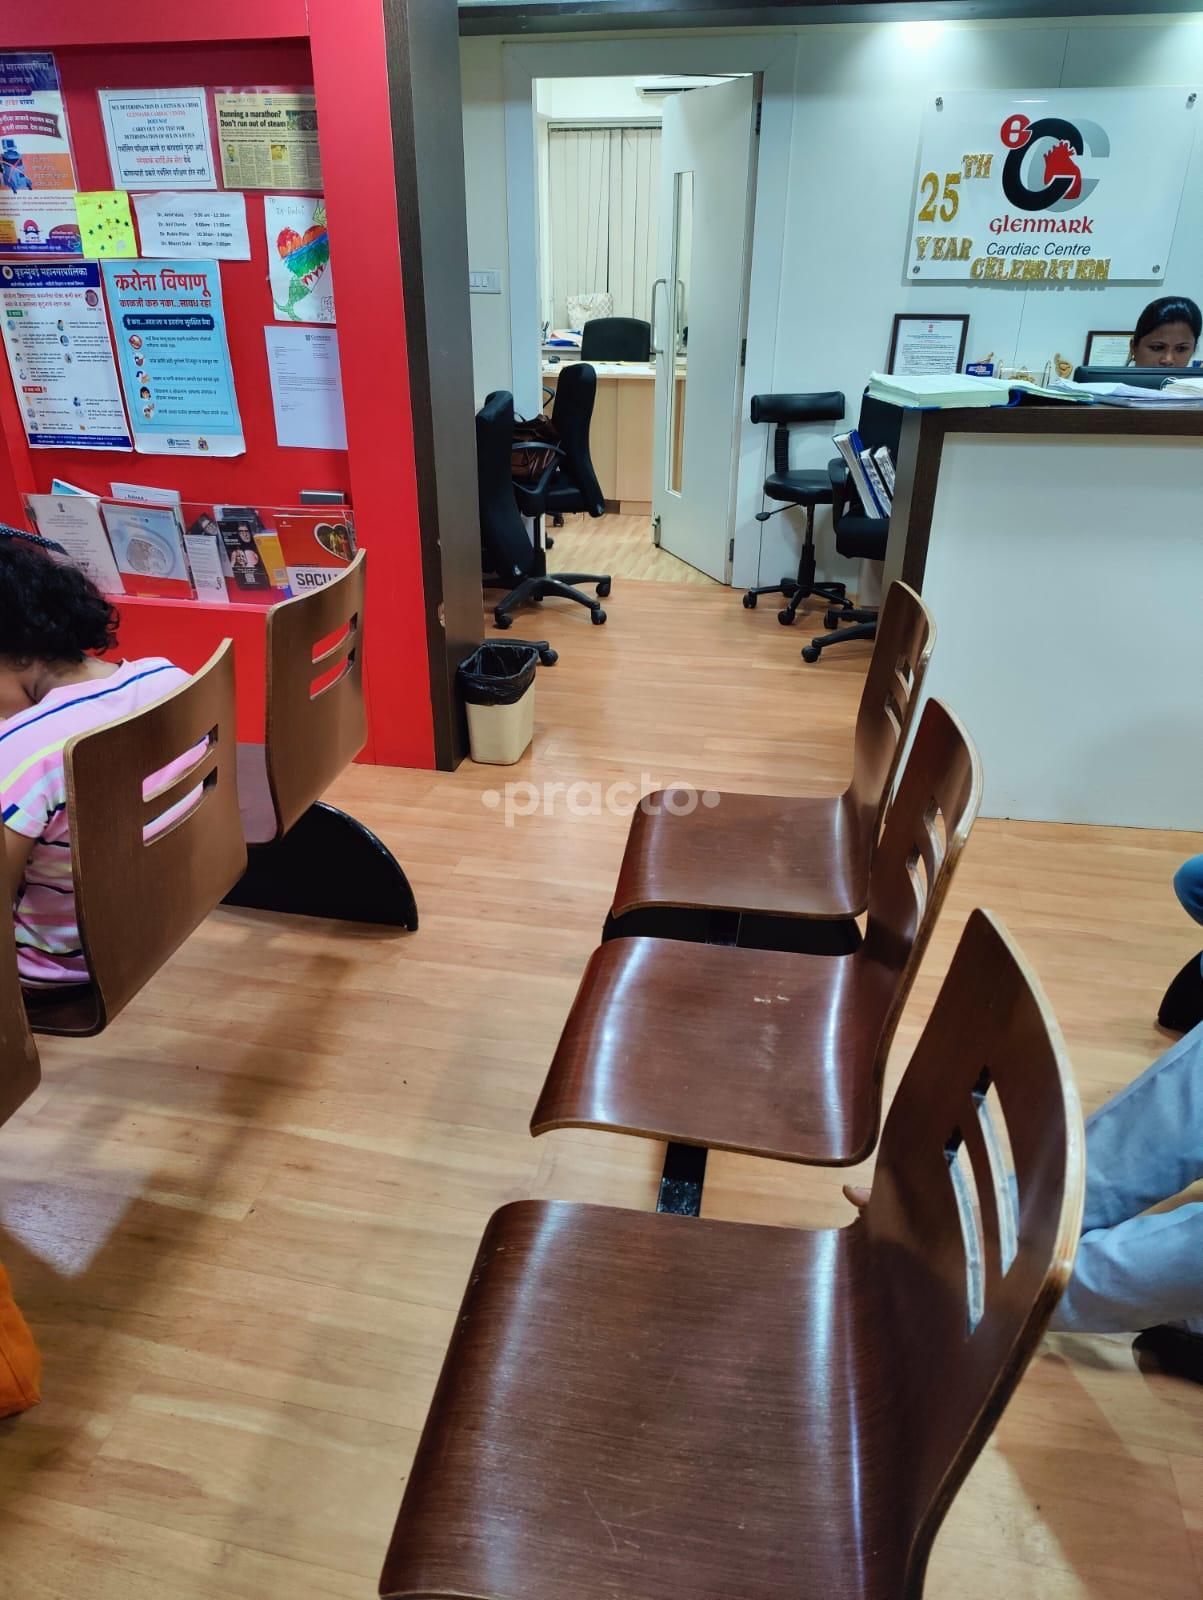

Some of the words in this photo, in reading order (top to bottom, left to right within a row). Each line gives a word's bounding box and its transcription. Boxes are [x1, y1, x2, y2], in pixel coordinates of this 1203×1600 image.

[219, 110, 244, 119] Running
[250, 110, 282, 118] marathon?
[220, 119, 236, 127] Don't
[918, 171, 962, 223] 25
[962, 154, 993, 179] TH
[915, 236, 973, 261] YEAR
[986, 242, 1040, 256] Cardiac
[1044, 242, 1091, 256] Centre
[114, 269, 156, 291] करोना
[159, 269, 211, 297] विषाणू
[119, 298, 144, 308] काळजी
[199, 299, 212, 308] रहा
